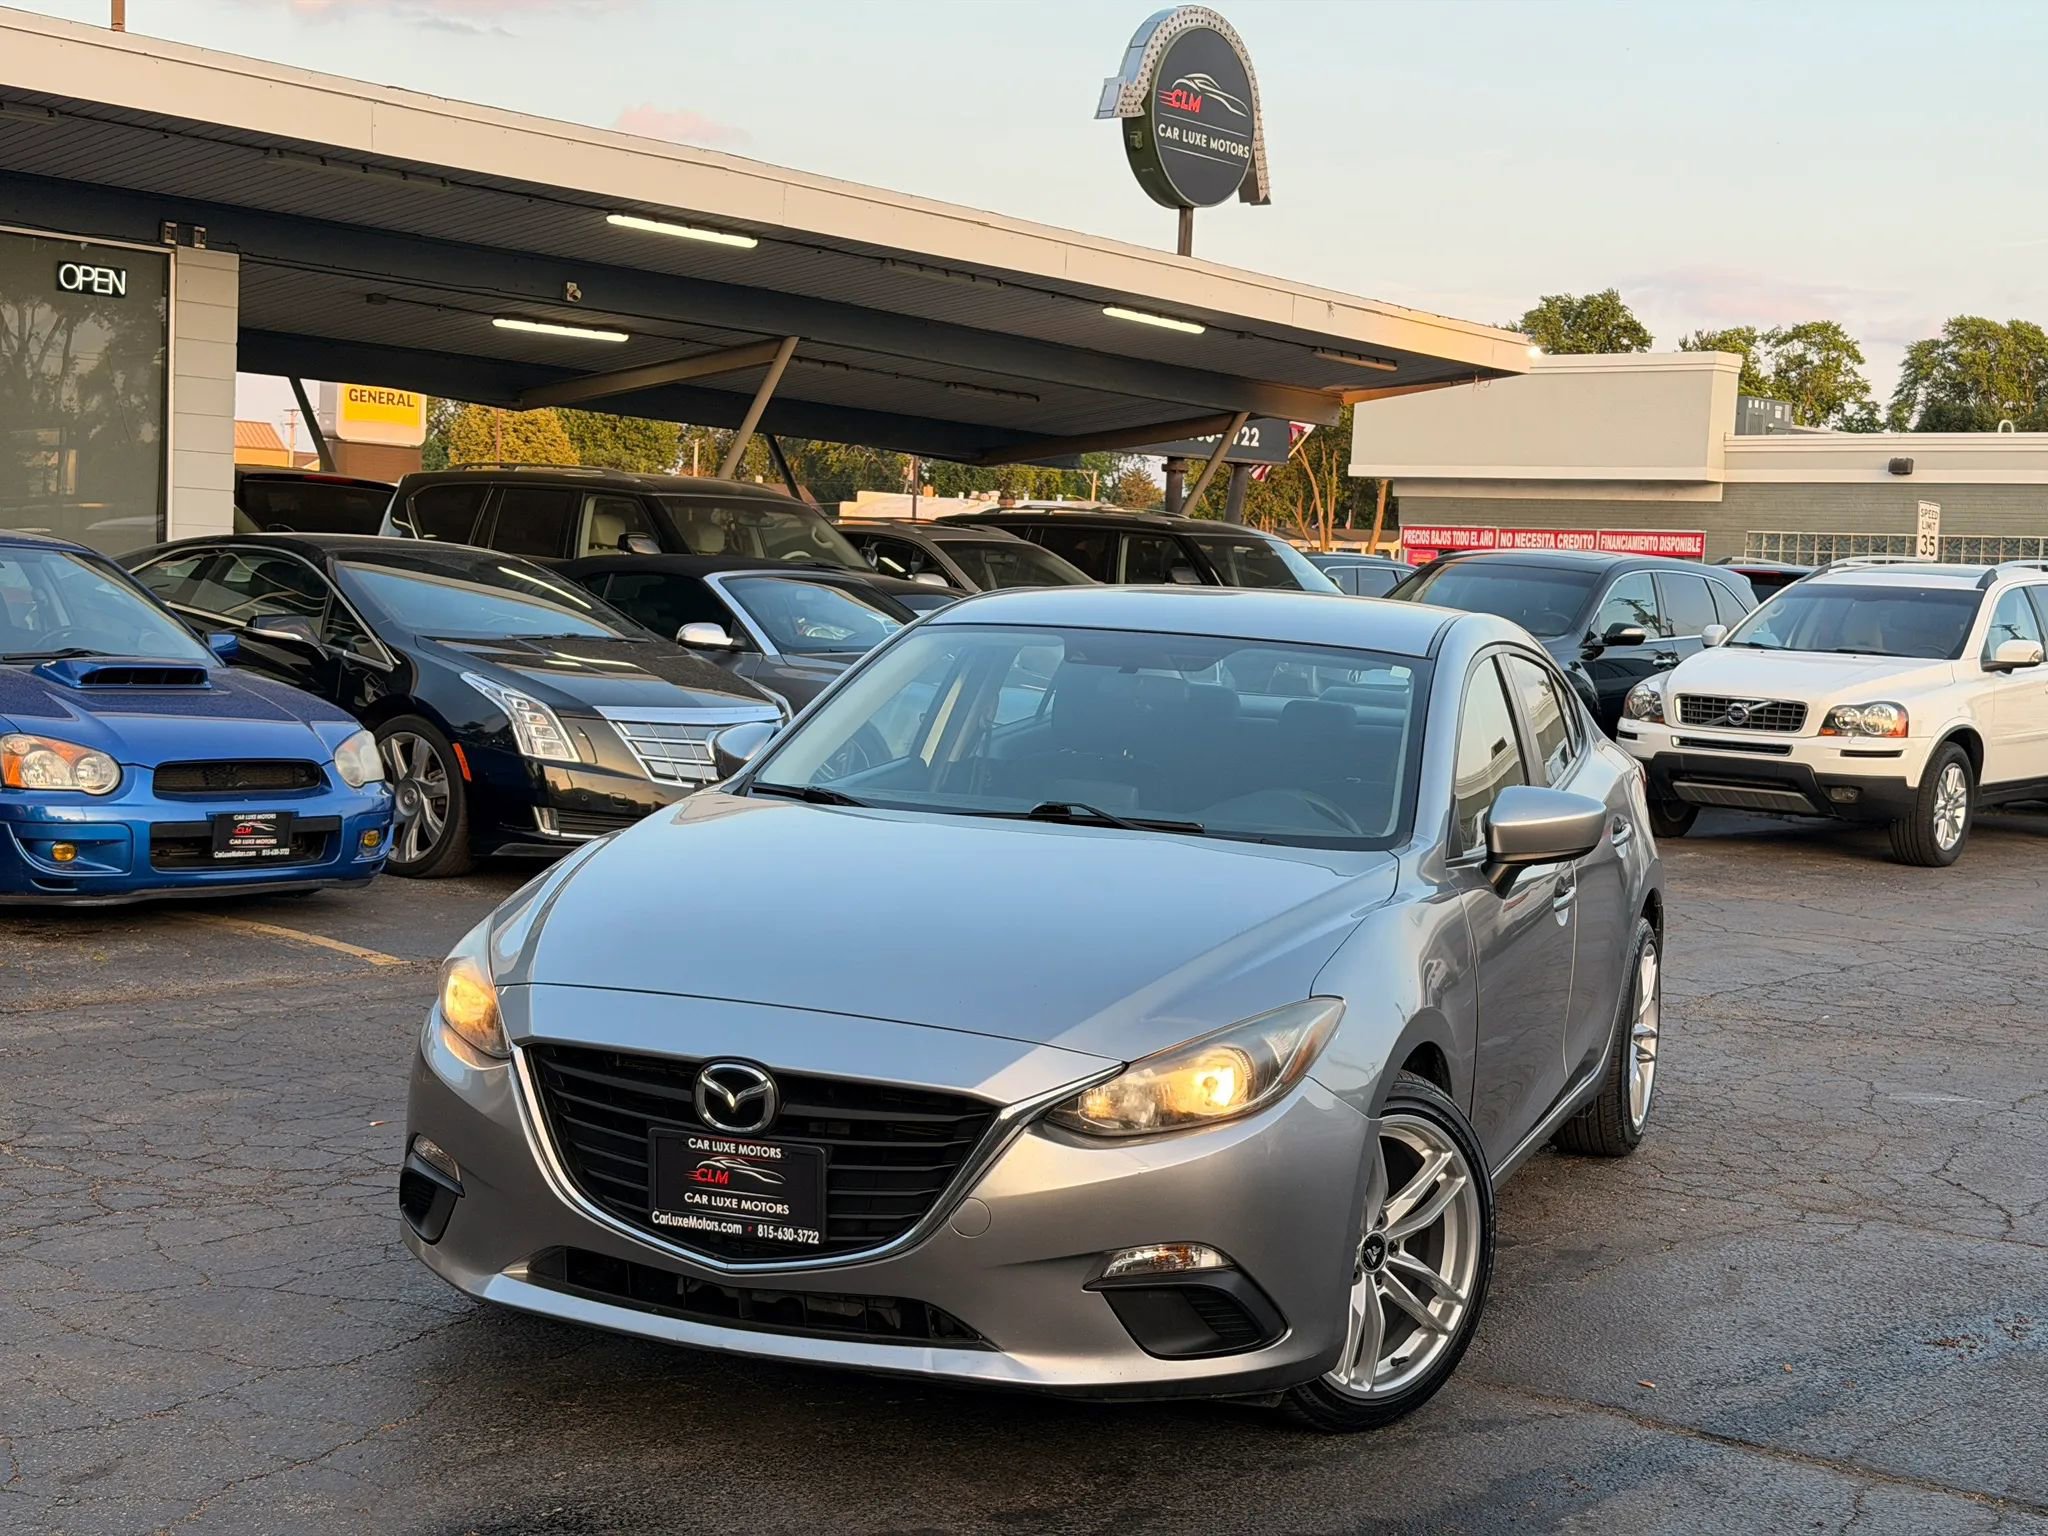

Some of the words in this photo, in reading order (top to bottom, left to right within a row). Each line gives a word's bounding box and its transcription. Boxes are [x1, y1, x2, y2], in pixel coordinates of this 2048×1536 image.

[1170, 88, 1204, 113] CLM
[1157, 124, 1180, 142] CAR
[1182, 129, 1208, 148] LUXE
[1209, 135, 1250, 159] MOTORS
[58, 262, 127, 295] OPEN
[348, 387, 416, 408] GENERAL
[1920, 508, 1938, 520] SPEED
[1921, 520, 1936, 531] LIMIT
[1403, 529, 1430, 545] PRECIOS
[1431, 530, 1452, 545] BAJOS
[1452, 530, 1470, 546] TODO
[1470, 531, 1479, 546] EL
[1500, 532, 1513, 547] NO
[1514, 532, 1555, 549] NECESITA
[1556, 533, 1595, 549] CREDITO
[1600, 534, 1659, 551] FINANCIAMIENTO
[1659, 536, 1702, 552] DISPONIBLE
[1920, 534, 1936, 556] 35
[688, 1138, 710, 1151] CAR
[712, 1140, 736, 1153] LUXE
[738, 1144, 782, 1159] MOTORS
[697, 1168, 730, 1184] CLM
[684, 1192, 708, 1204] CAR
[711, 1194, 738, 1209] LUXE
[741, 1200, 790, 1215] MOTORS
[652, 1211, 743, 1235] CarLuxeMotors.com
[757, 1224, 820, 1245] 815-630-3722
